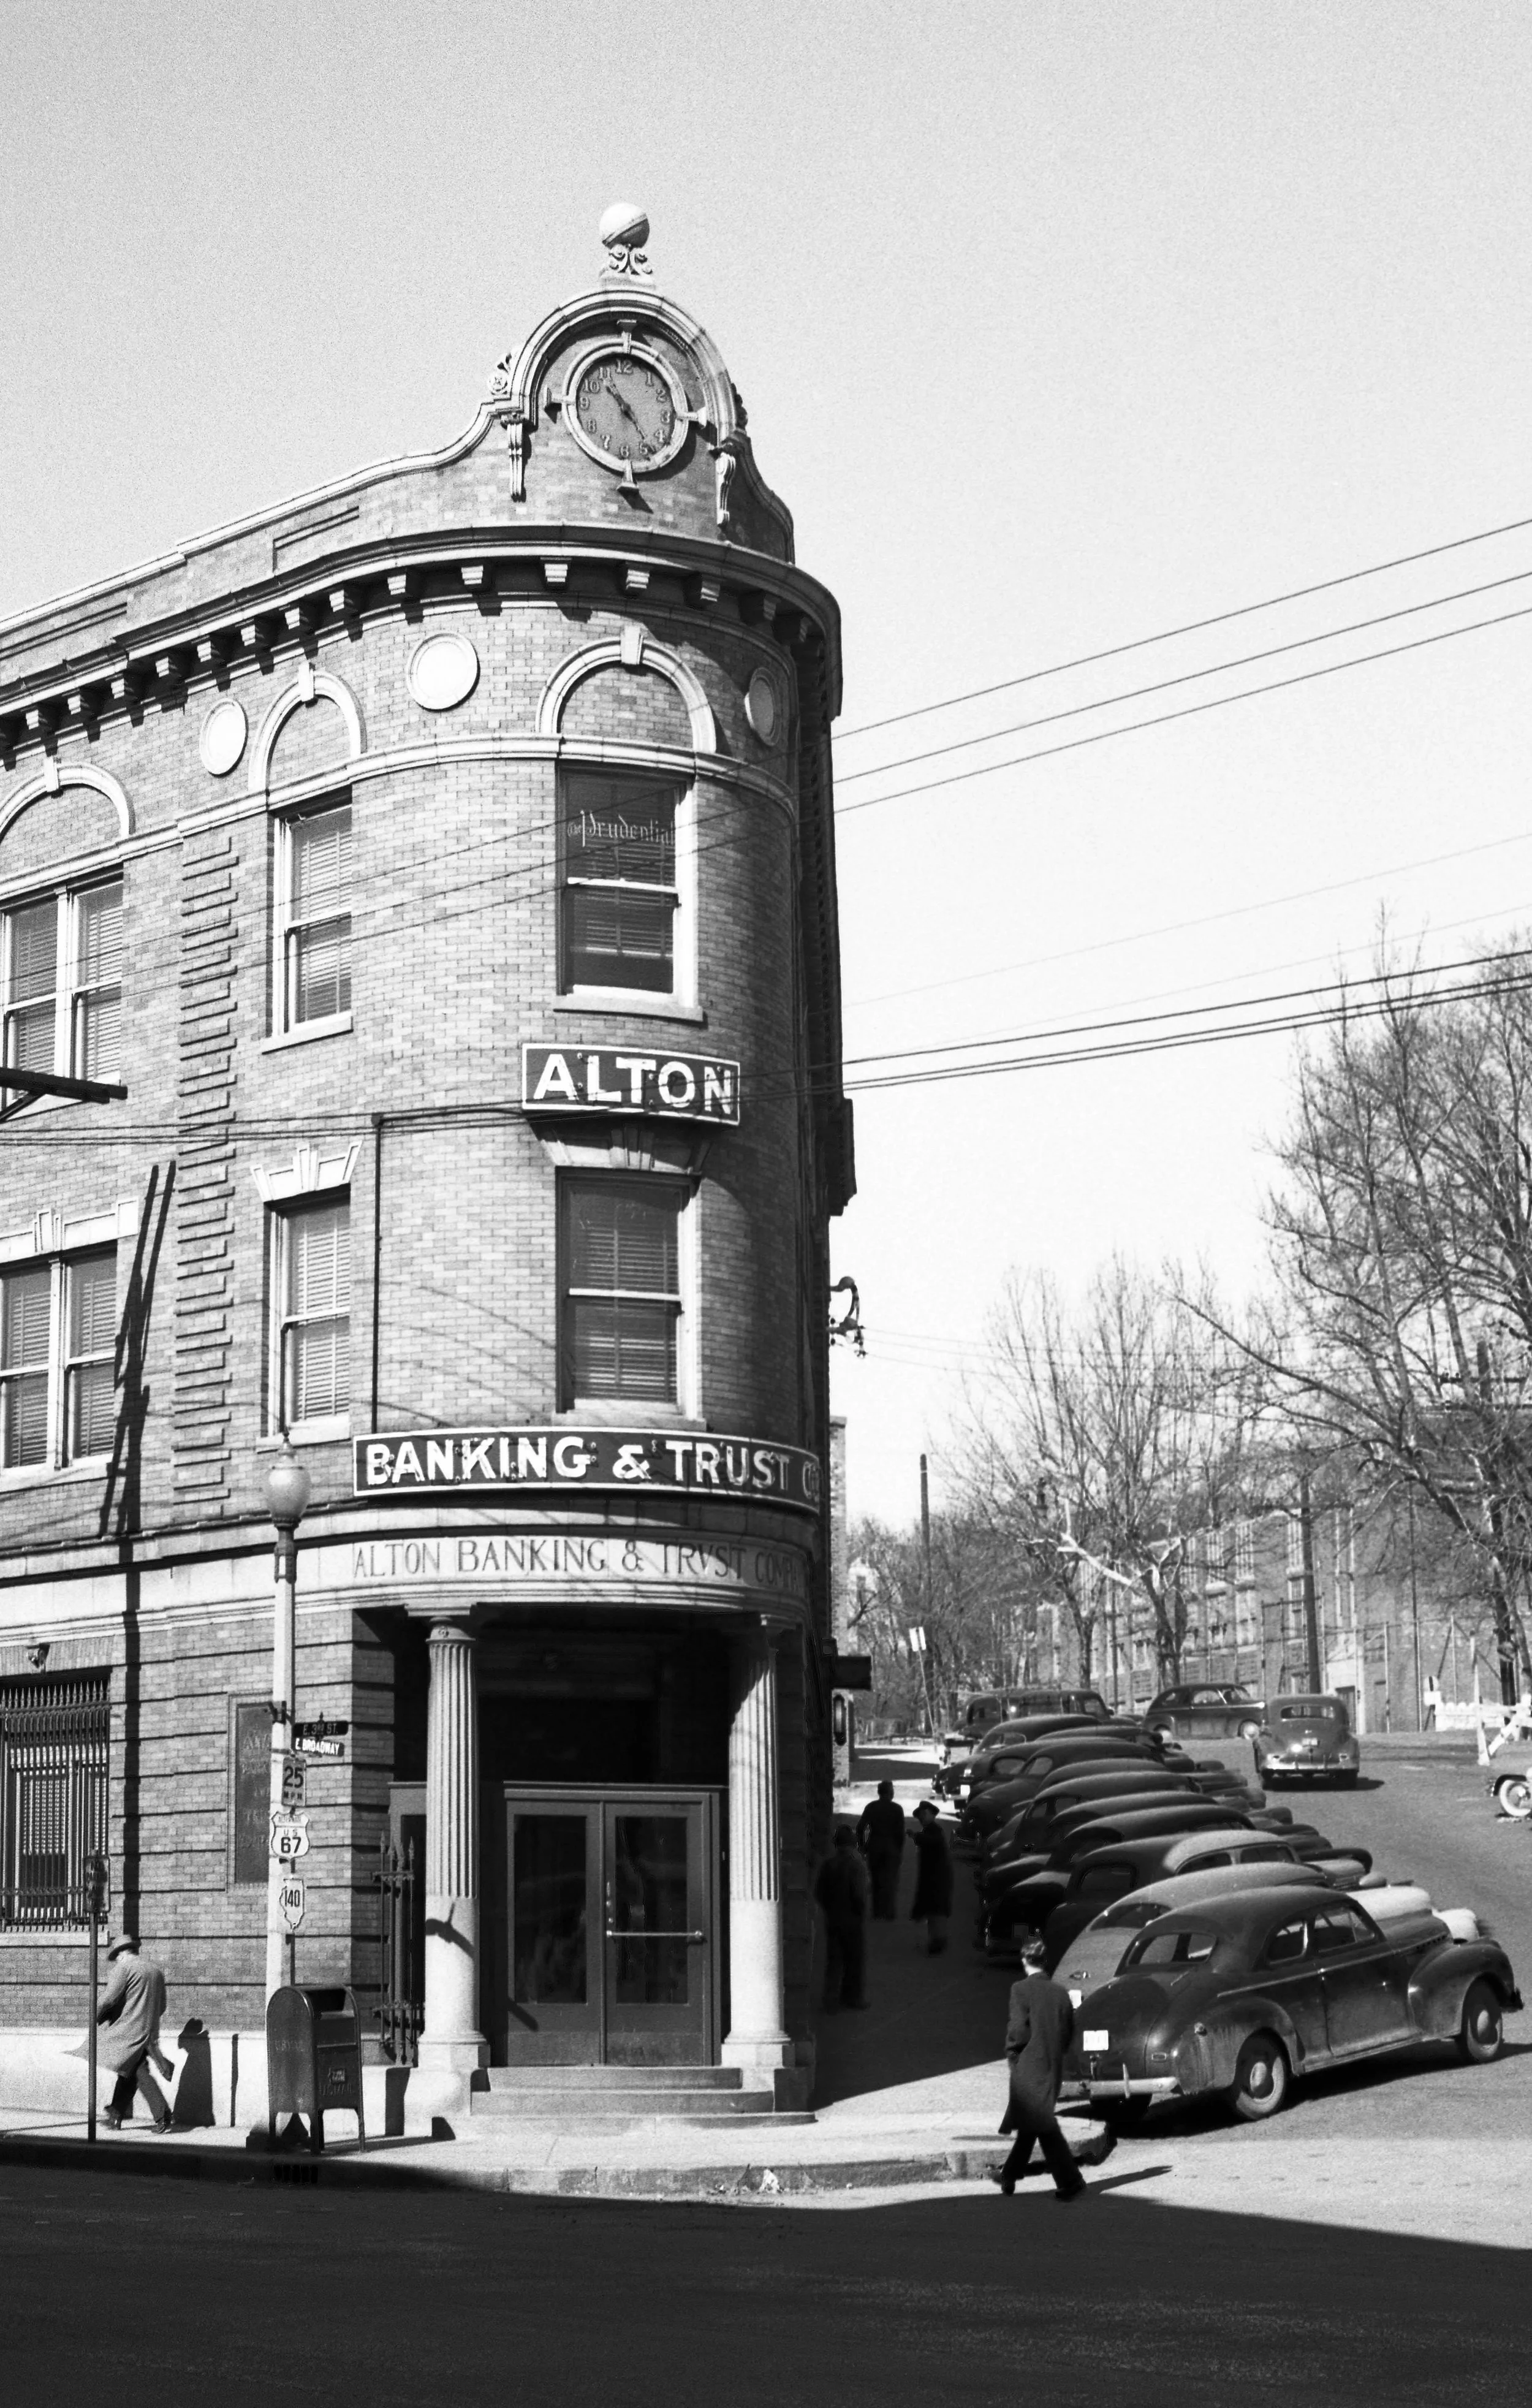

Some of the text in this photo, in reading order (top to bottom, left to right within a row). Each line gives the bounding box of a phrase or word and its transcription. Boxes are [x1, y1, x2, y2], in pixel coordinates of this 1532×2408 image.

[597, 367, 612, 381] 11
[615, 359, 633, 374] 12
[583, 379, 601, 393] 10
[646, 371, 654, 387] 1
[656, 388, 666, 403] 2
[579, 397, 590, 410] 9
[661, 410, 670, 423] 3
[587, 419, 597, 433] 8
[601, 435, 611, 450] 7
[654, 429, 666, 444] 4
[620, 445, 630, 459] 6
[639, 441, 648, 455] 5
[533, 1054, 732, 1115] ALTON
[366, 1435, 591, 1486] BANKING
[613, 1444, 652, 1480] &
[665, 1440, 789, 1491] TRUST
[353, 1541, 441, 1578] ALTON
[458, 1538, 606, 1573] BANKING
[621, 1539, 645, 1572] &
[302, 1738, 340, 1756] BROADWAY
[284, 1766, 304, 1788] 25
[281, 1836, 301, 1854] 67
[284, 1889, 300, 1907] 140
